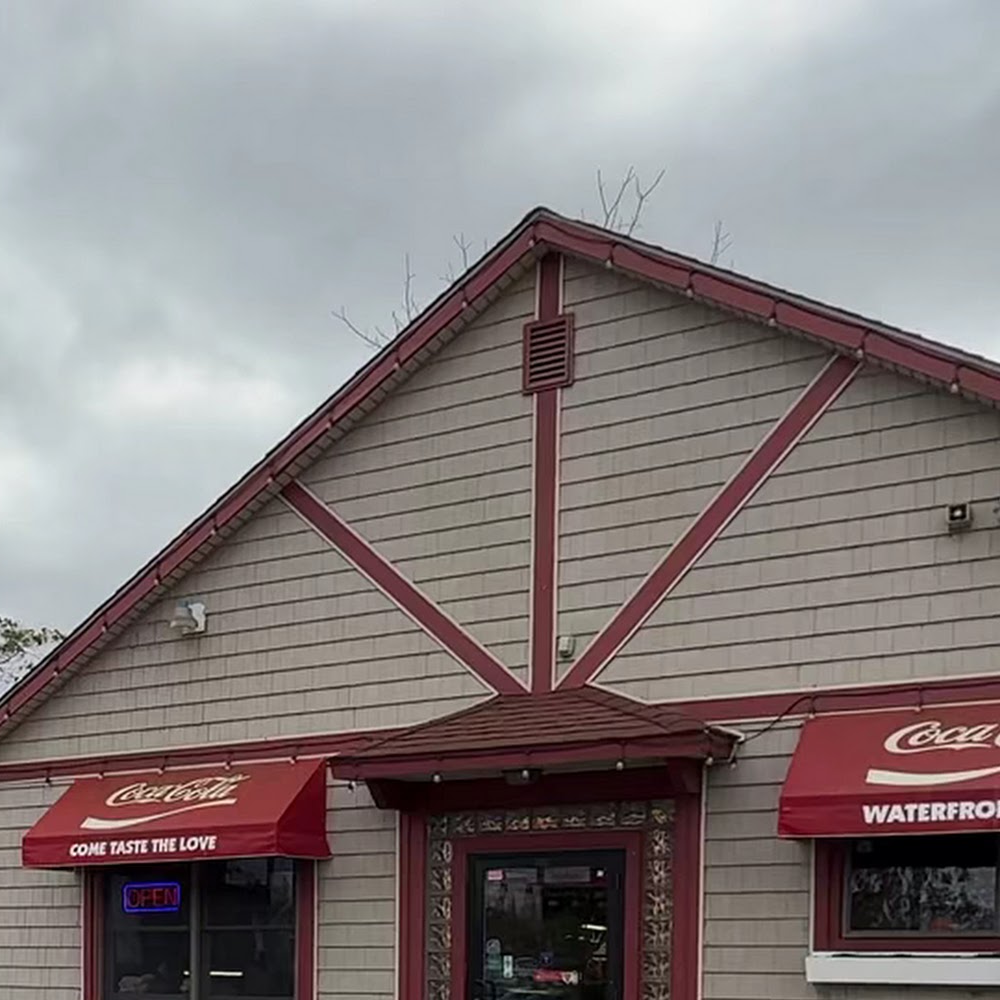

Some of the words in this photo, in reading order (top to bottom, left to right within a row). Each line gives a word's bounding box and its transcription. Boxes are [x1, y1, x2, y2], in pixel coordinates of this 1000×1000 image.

[862, 800, 1000, 824] WATERFRO
[69, 841, 107, 857] COME
[110, 838, 148, 855] TASTE
[151, 837, 177, 853] THE
[179, 835, 218, 851] LOVE
[127, 886, 178, 908] OPEN
